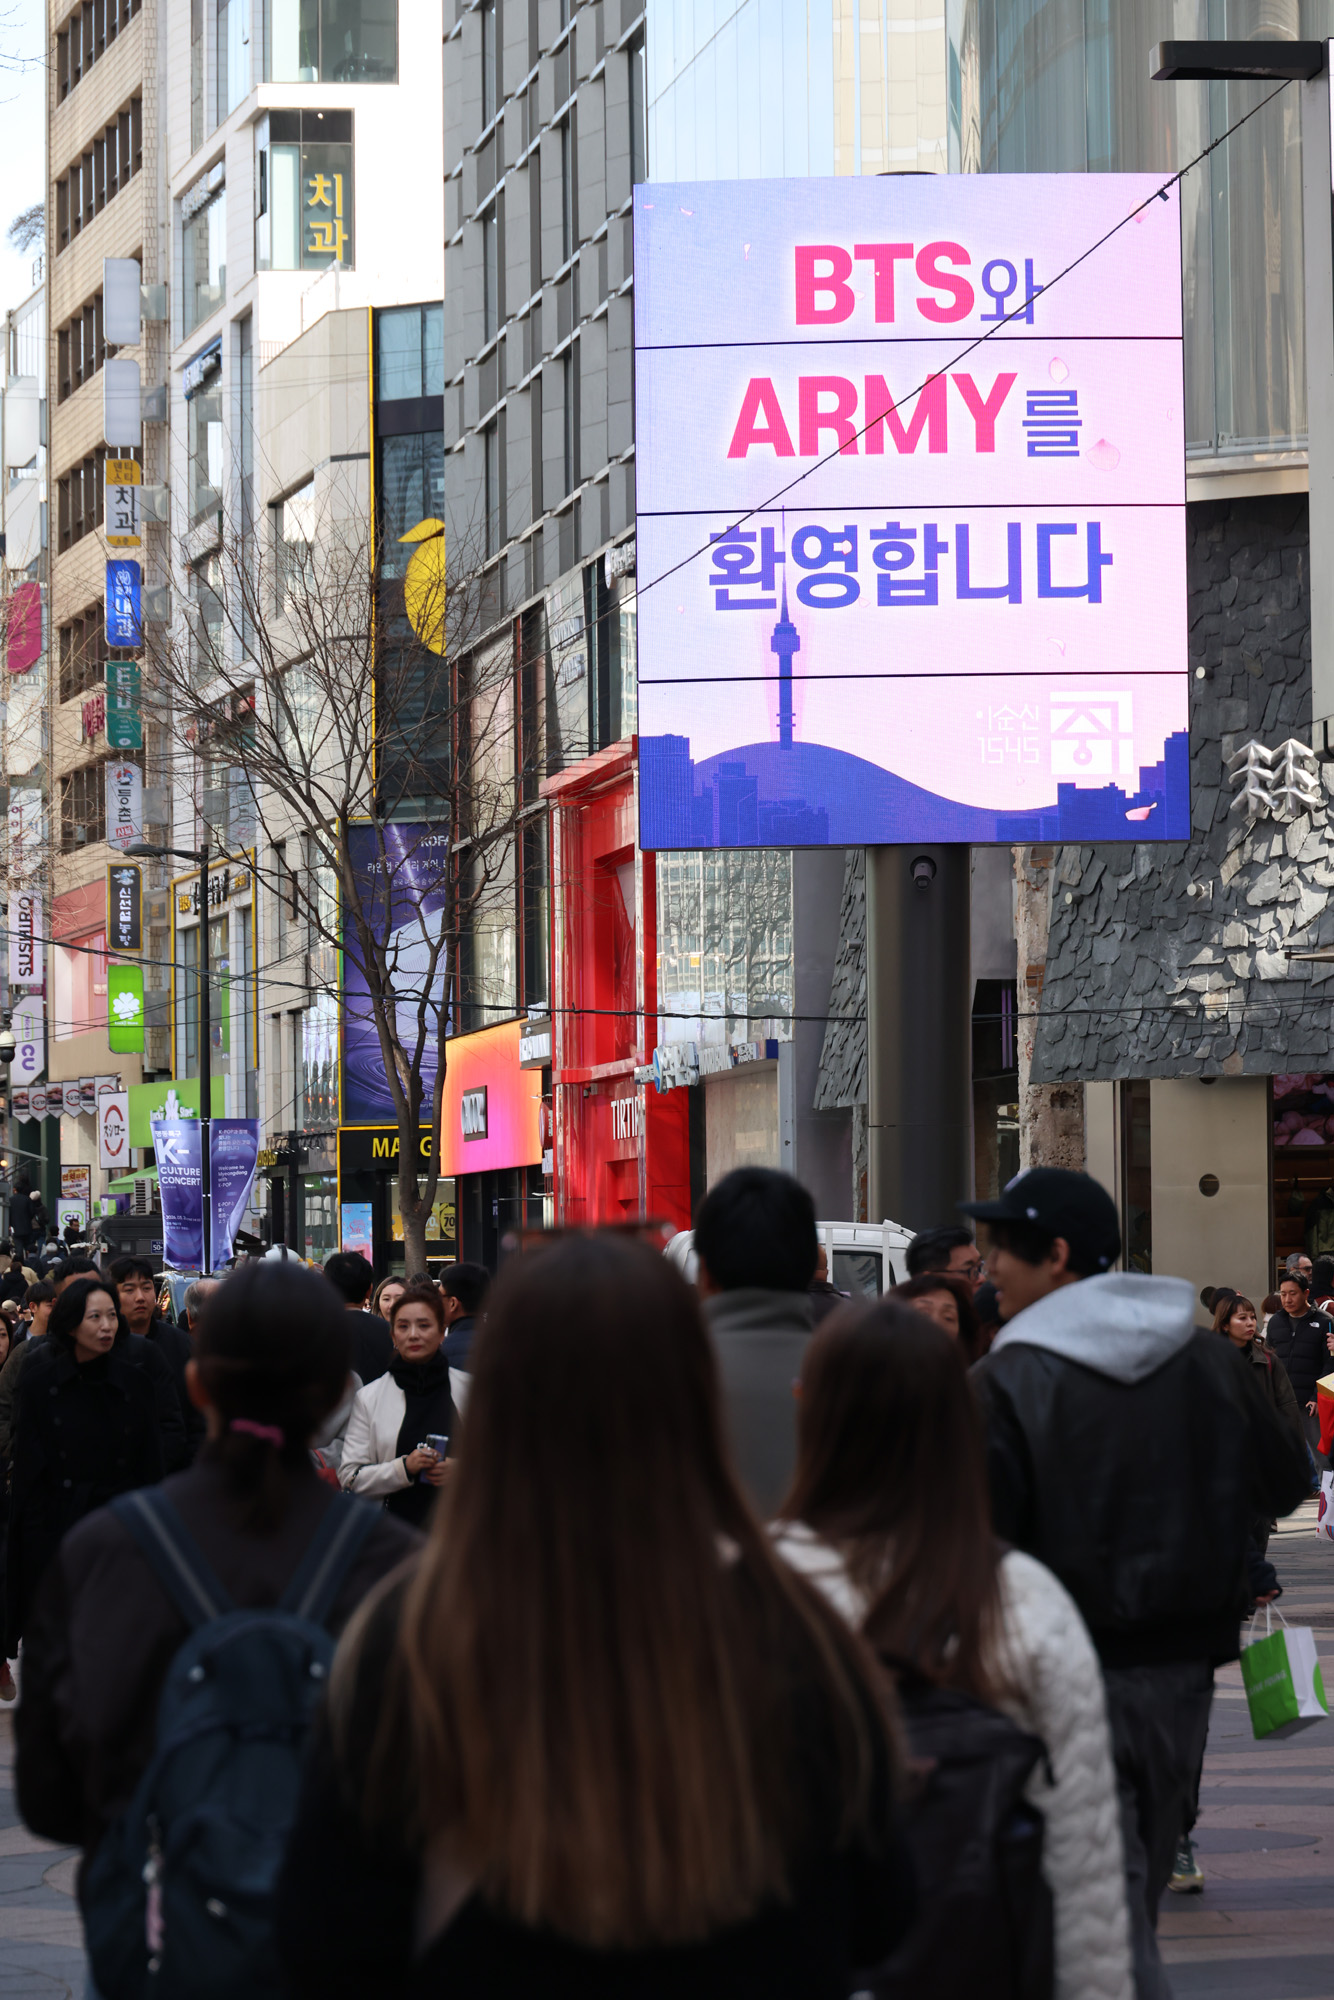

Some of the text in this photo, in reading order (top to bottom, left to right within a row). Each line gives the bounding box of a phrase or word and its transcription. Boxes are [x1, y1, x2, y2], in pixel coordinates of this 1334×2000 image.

[308, 173, 349, 261] 치과
[794, 241, 1043, 325] BTS와
[727, 372, 1083, 458] ARMY를
[115, 486, 138, 535] 치과
[708, 521, 1113, 611] 환영합니다
[976, 704, 1039, 731] 이순신
[977, 736, 1039, 764] 1545
[120, 840, 131, 849] 3F
[18, 896, 32, 977] SUSHIRO
[21, 1044, 35, 1071] CU
[160, 1166, 201, 1176] CULTURE
[161, 1176, 201, 1186] CONCERT
